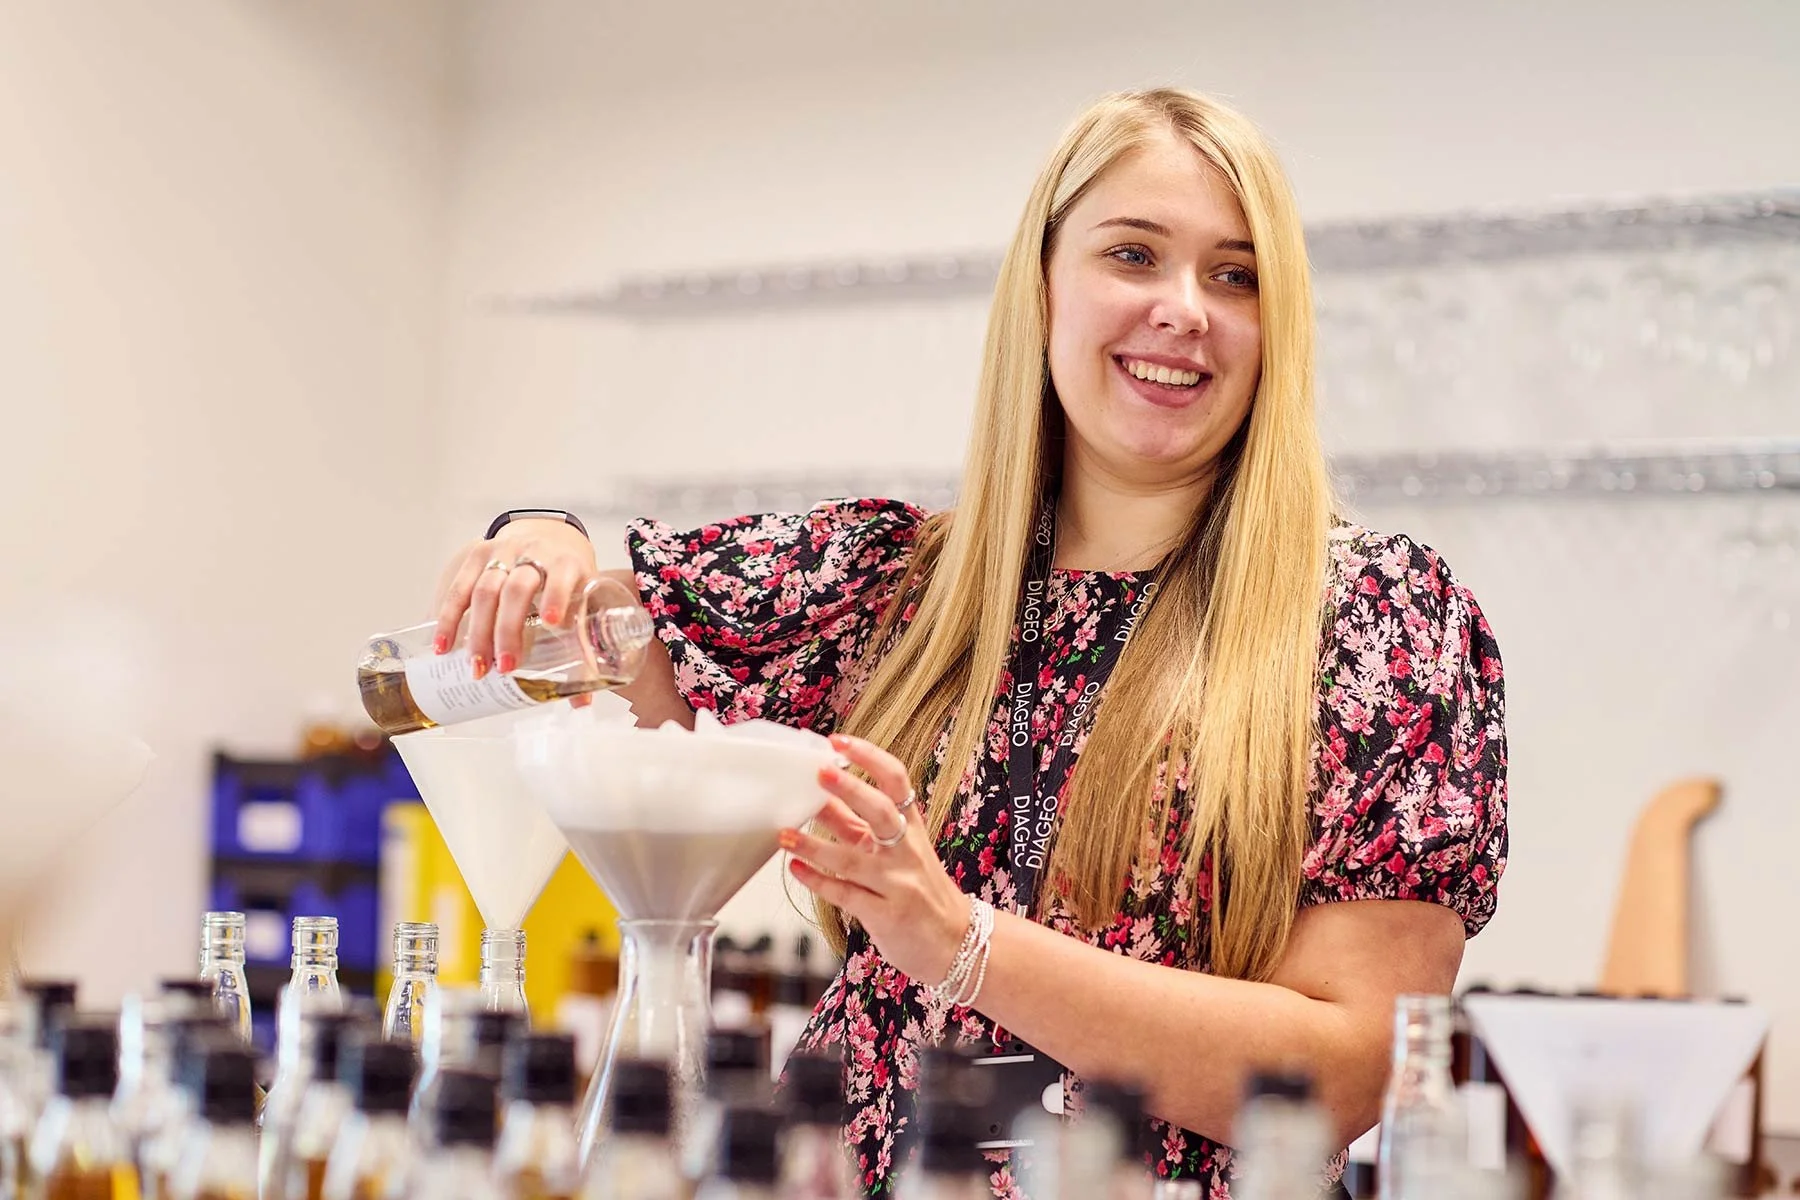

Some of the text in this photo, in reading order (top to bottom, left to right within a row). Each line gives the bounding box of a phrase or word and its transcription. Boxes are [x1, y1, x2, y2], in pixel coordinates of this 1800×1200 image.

[1022, 580, 1043, 643] DIAGEO
[1012, 682, 1033, 747] DIAGEO
[1060, 681, 1100, 747] DIAGEO
[1026, 795, 1058, 870] DIAGEO
